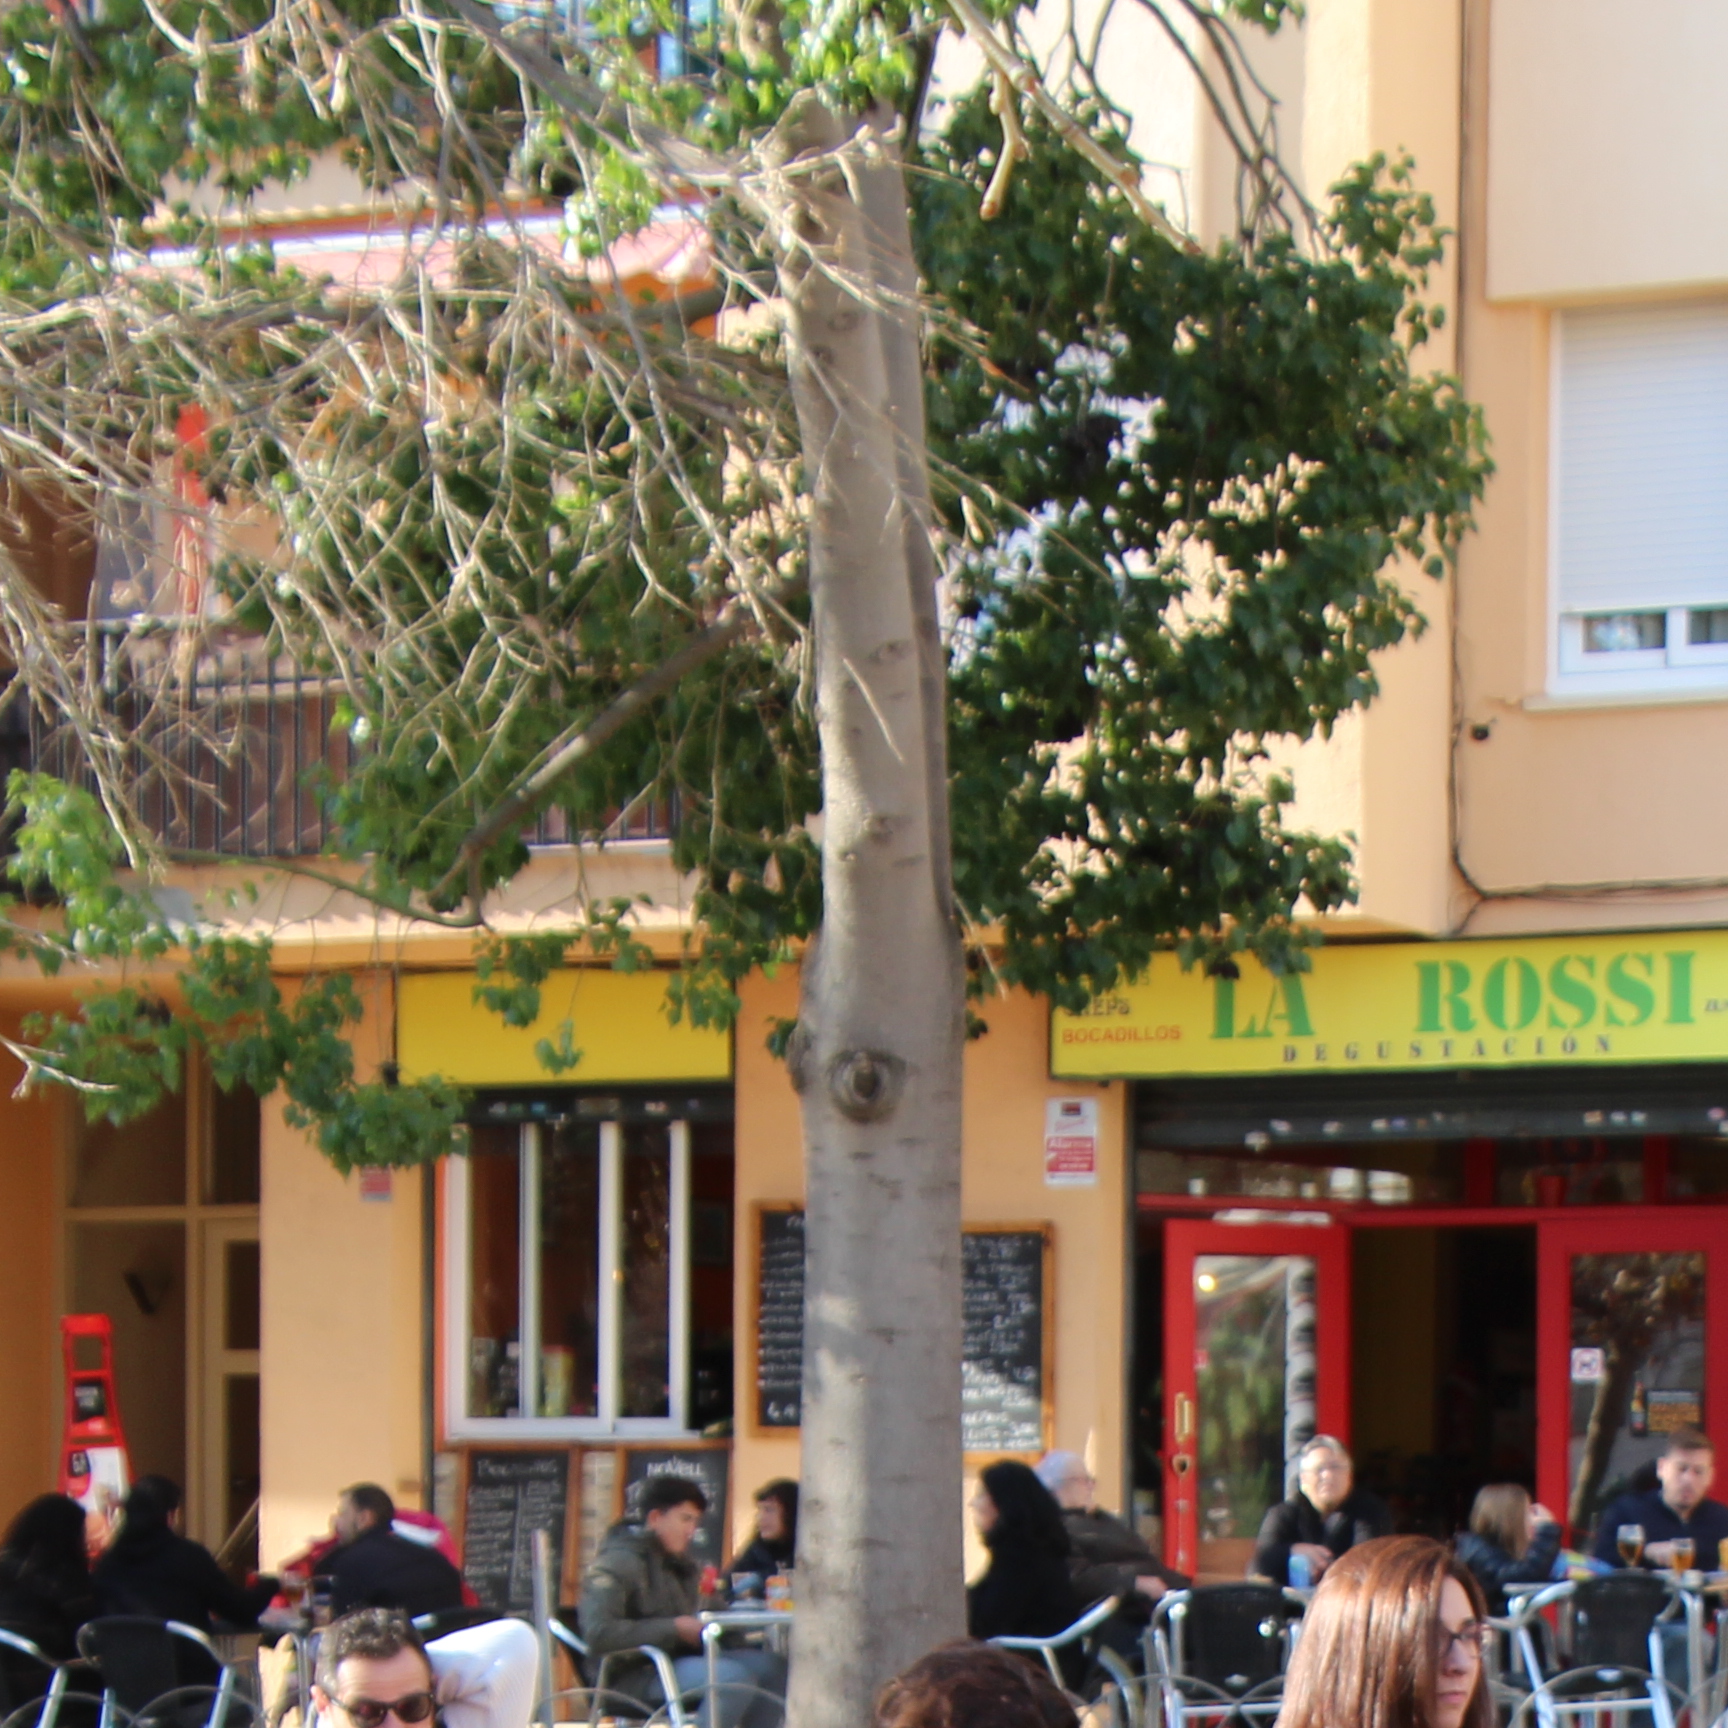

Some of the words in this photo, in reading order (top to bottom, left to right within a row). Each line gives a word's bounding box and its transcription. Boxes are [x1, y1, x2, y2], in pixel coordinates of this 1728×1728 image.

[1209, 964, 1315, 1039] LA
[1414, 951, 1696, 1032] ROSSI
[1062, 1025, 1182, 1044] BOCADILLOS
